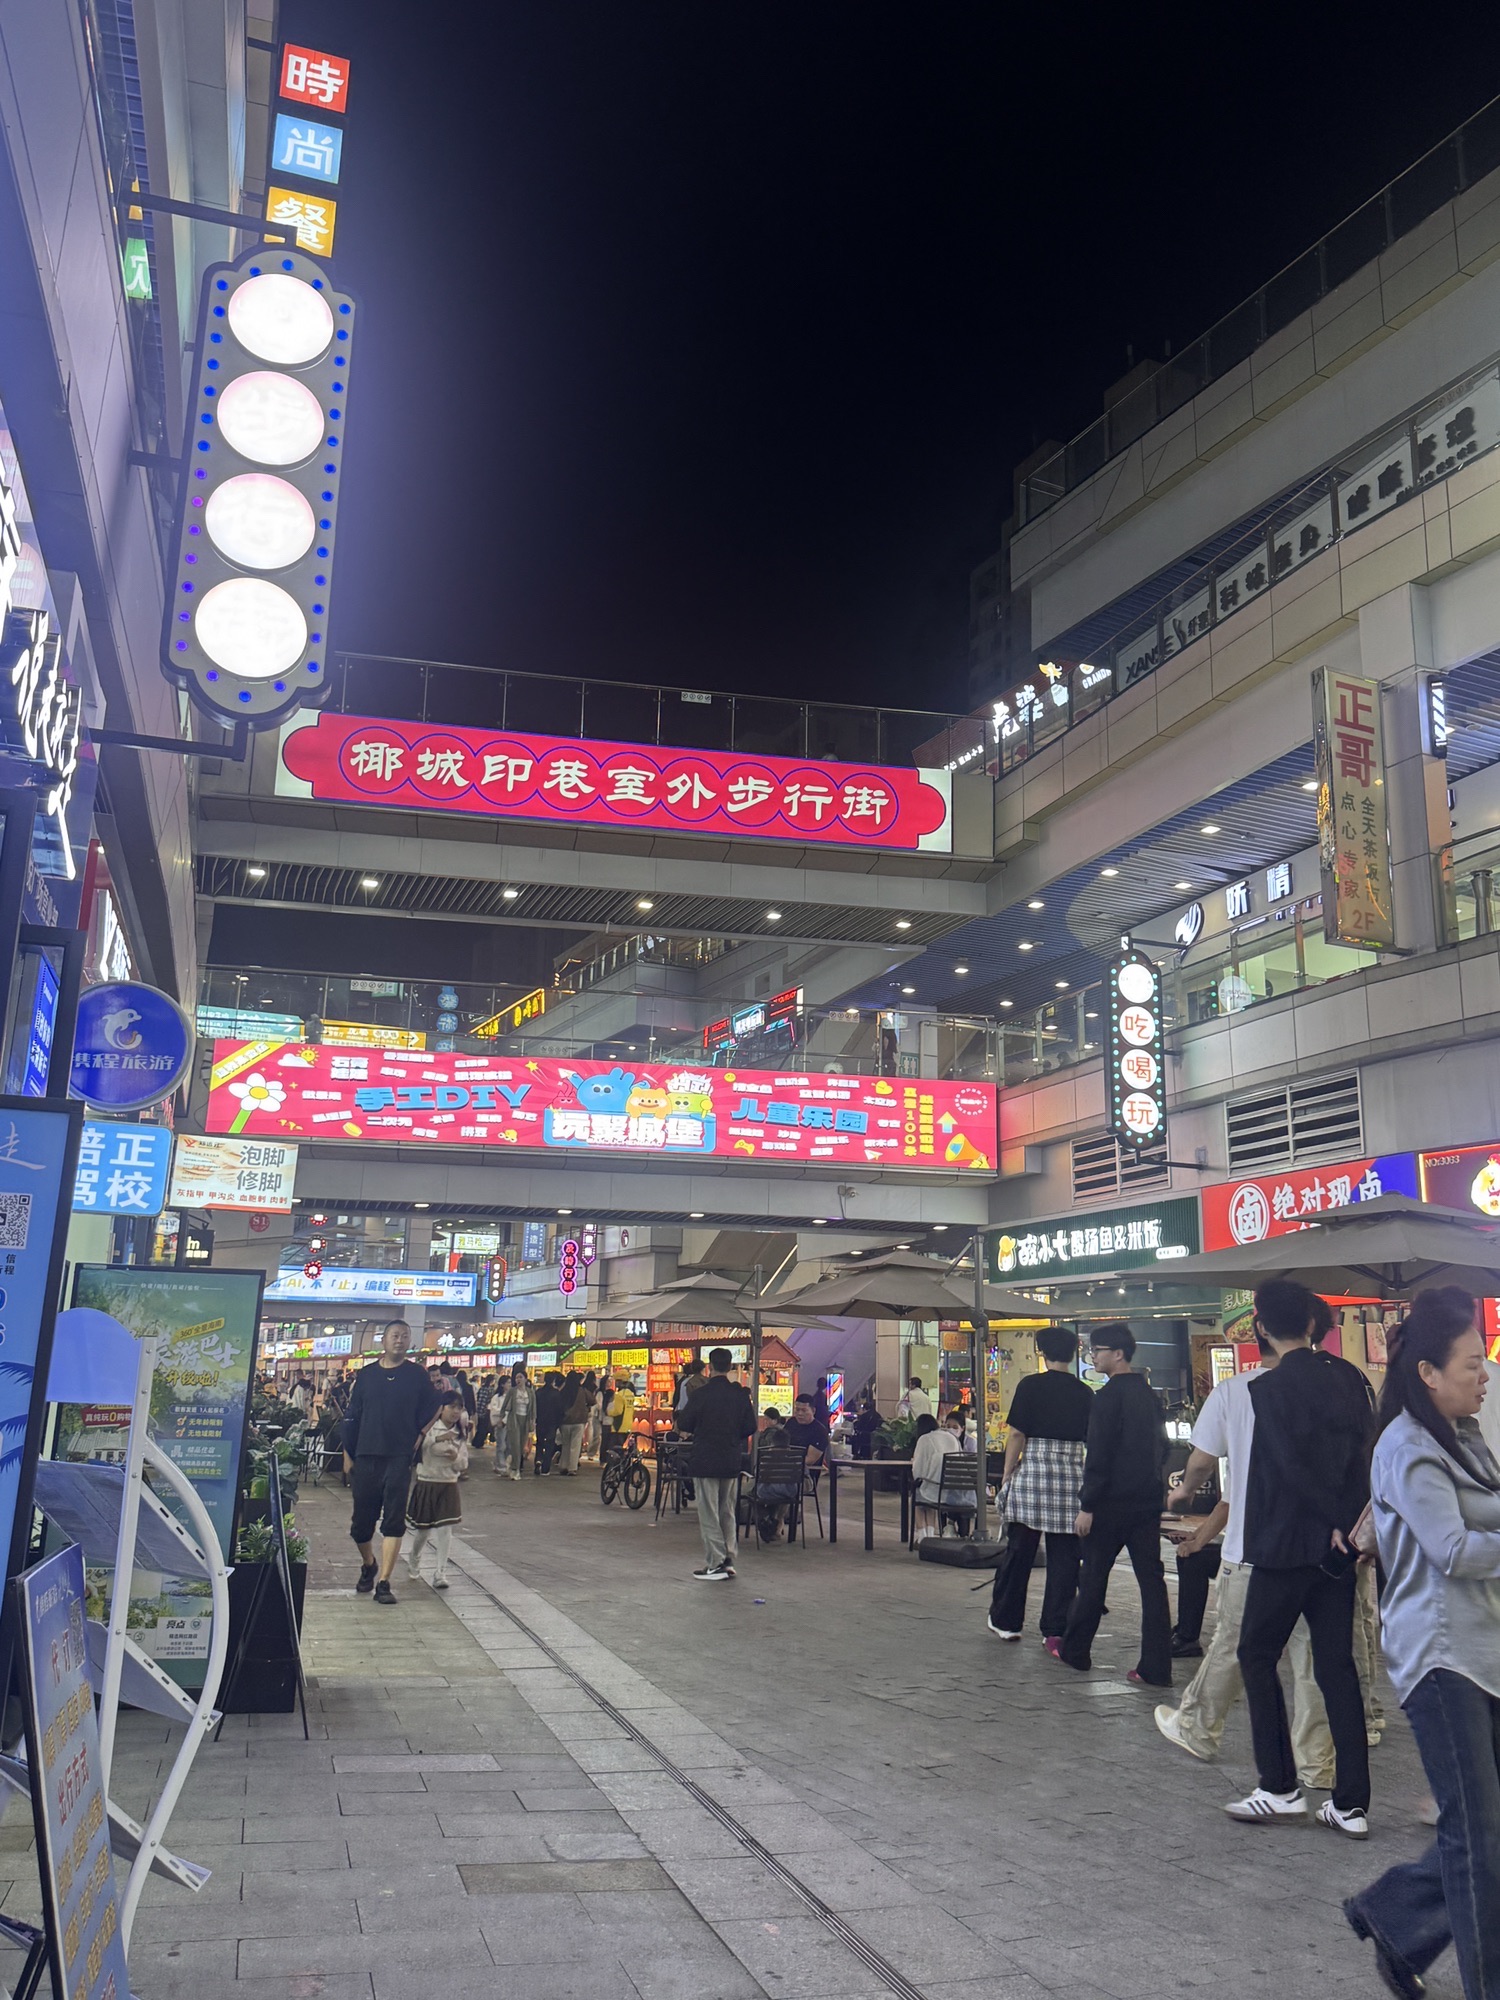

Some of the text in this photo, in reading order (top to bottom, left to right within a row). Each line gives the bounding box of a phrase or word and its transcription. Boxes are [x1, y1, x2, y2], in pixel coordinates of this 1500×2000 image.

[1333, 680, 1377, 788] 正哥
[348, 739, 890, 827] 椰城印巷室外步行街
[1352, 910, 1375, 931] 2F
[73, 1053, 176, 1072] 携程旅游
[1124, 1014, 1155, 1127] 吃喝玩
[354, 1083, 533, 1111] 手工DIY
[729, 1097, 869, 1135] 儿童乐园
[239, 1145, 286, 1168] 泡脚
[236, 1170, 283, 1193] 修脚
[1272, 1168, 1383, 1220] 绝对现卤
[188, 1418, 223, 1427] 无年龄限制
[166, 1619, 187, 1630] 亮点
[50, 1629, 72, 1689] 代订
[57, 1741, 91, 1827] 出行方式
